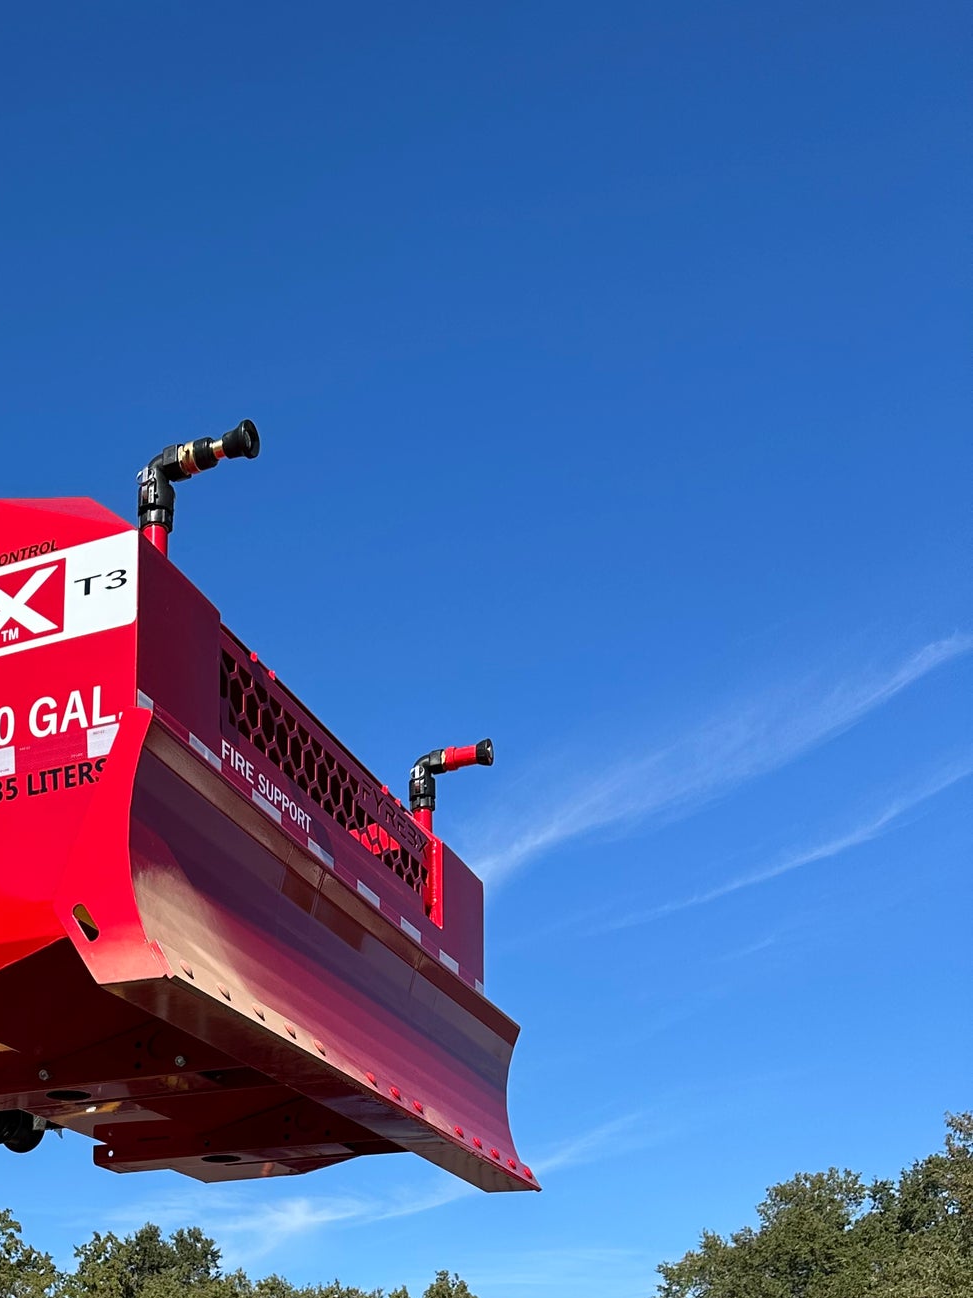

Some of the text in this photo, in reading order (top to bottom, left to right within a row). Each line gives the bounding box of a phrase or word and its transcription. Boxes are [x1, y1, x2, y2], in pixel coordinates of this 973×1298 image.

[74, 569, 128, 597] T3
[221, 738, 312, 834] FIRE SUPPORT
